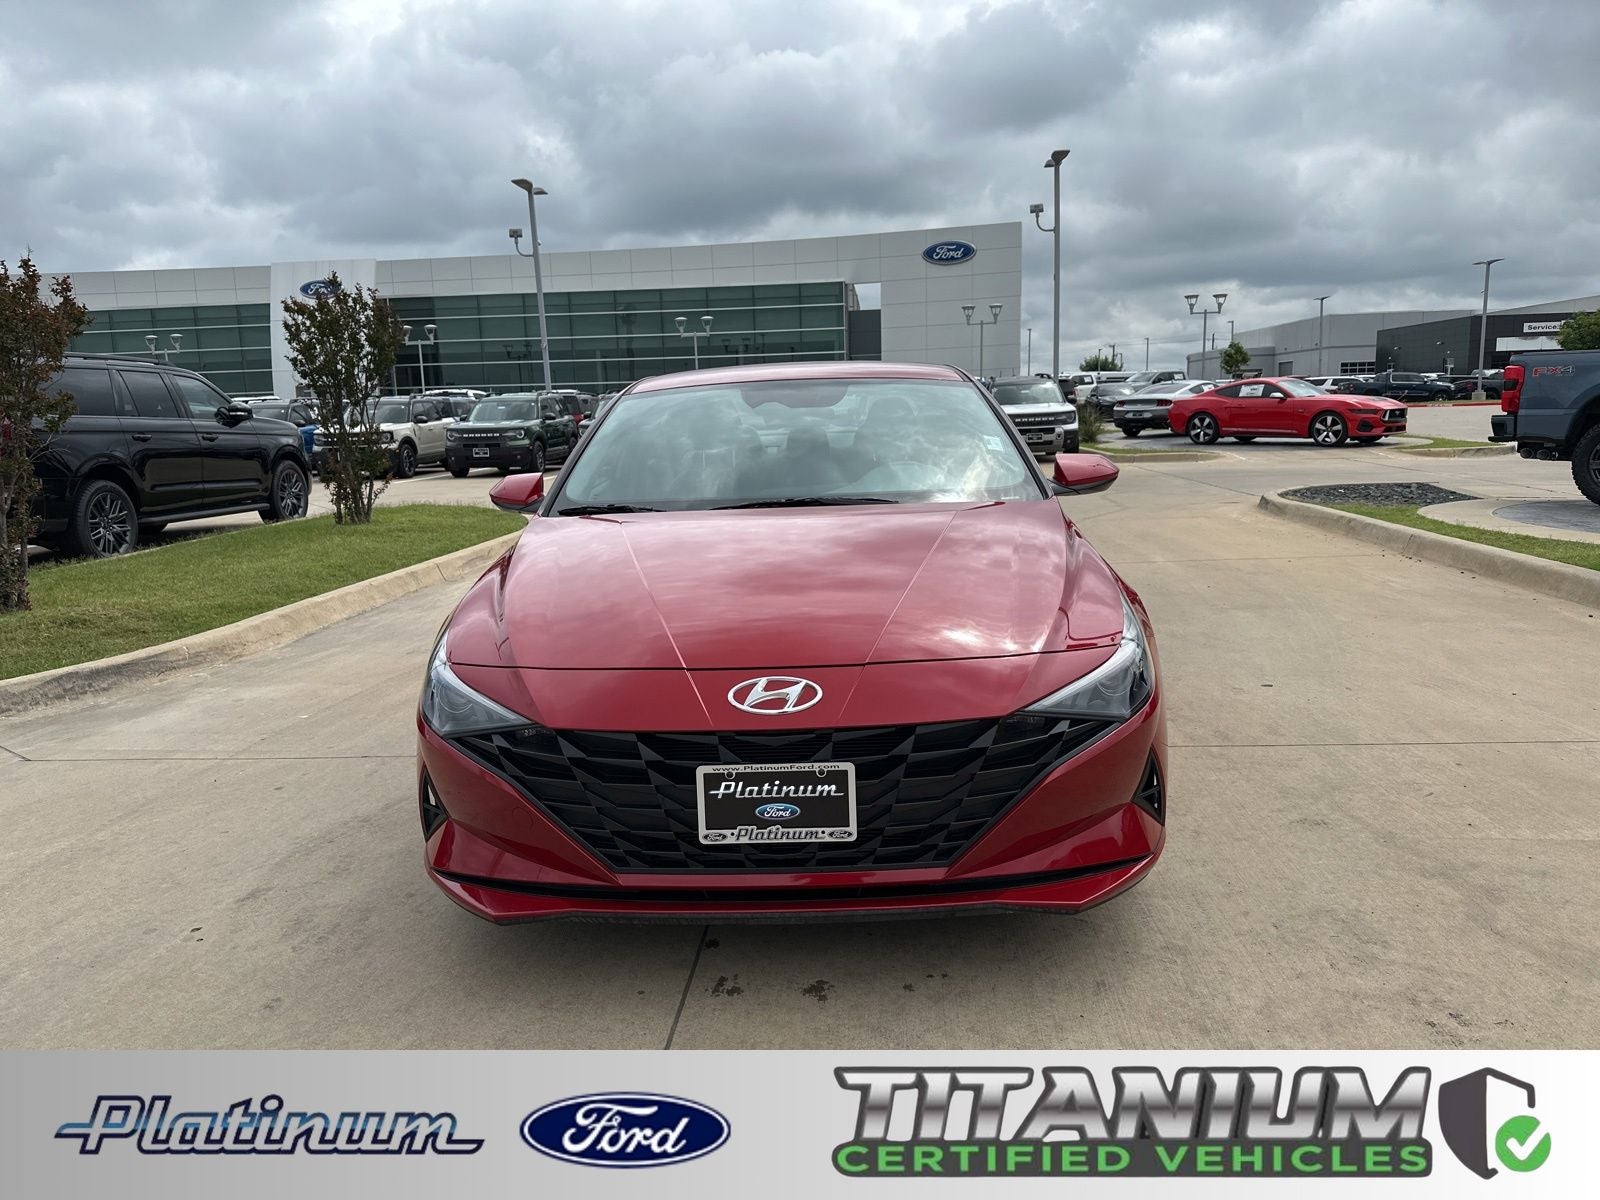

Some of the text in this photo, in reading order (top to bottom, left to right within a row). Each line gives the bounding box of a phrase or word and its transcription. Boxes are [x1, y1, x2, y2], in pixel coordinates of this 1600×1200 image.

[933, 245, 964, 259] Ford
[712, 764, 840, 772] www.PlatinumFord.com
[709, 780, 844, 799] Platinum
[764, 805, 792, 817] Ford
[736, 825, 825, 842] Platinum
